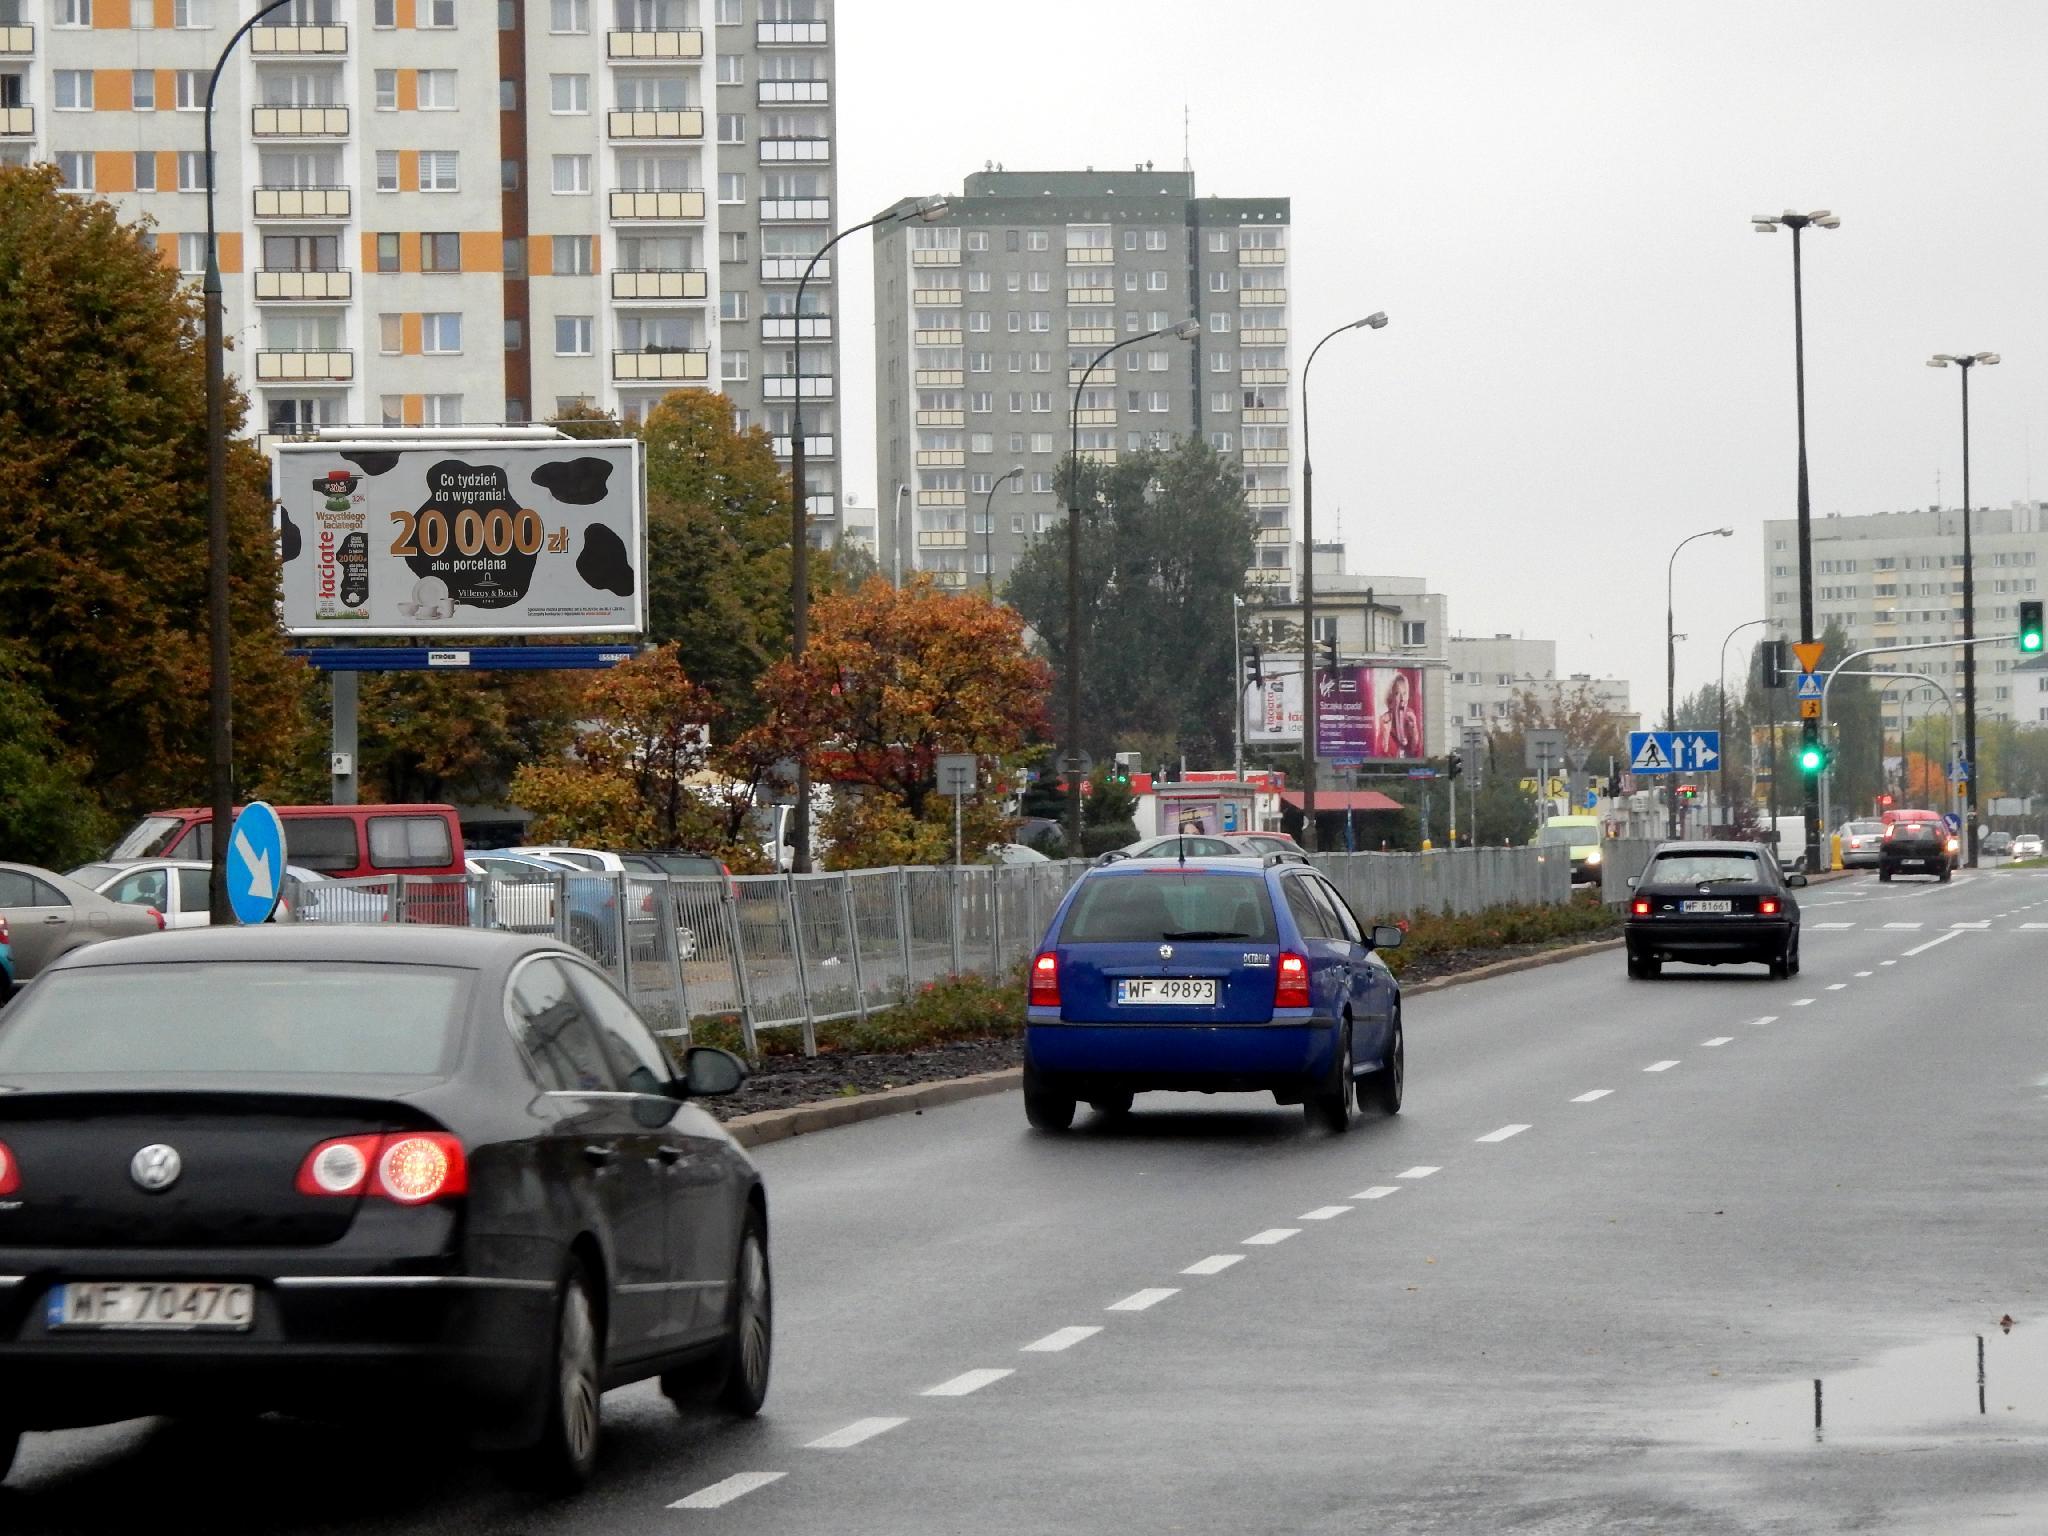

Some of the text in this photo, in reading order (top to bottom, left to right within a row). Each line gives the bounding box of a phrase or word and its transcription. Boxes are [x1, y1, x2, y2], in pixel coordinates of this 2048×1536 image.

[440, 472, 497, 490] Co tydzień
[435, 487, 507, 504] do wygrania!
[316, 511, 366, 522] Wszystkiego
[390, 507, 570, 557] 20 000 zł
[318, 531, 336, 599] łaciate
[431, 558, 507, 572] albo porcelana
[458, 589, 489, 598] Villeroy
[498, 588, 519, 597] Boch
[1685, 902, 1729, 911] WF 81661
[1129, 982, 1213, 999] WF 49893
